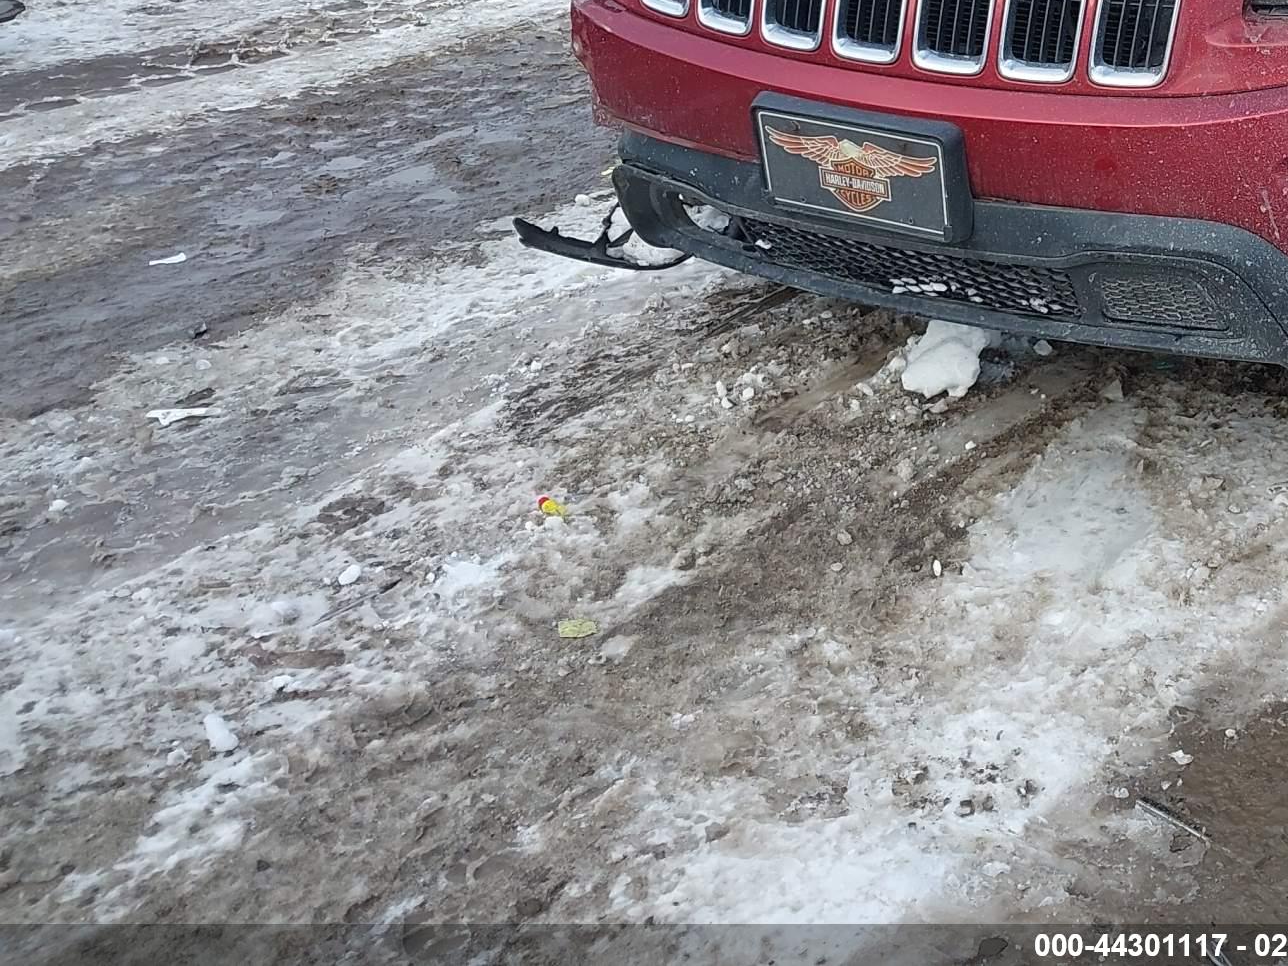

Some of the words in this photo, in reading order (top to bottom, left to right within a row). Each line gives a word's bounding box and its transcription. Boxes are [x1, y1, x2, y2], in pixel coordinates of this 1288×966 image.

[837, 162, 870, 177] MOTOR
[825, 172, 885, 195] HARLEY-DAVIDSON
[840, 189, 872, 205] CYCLES
